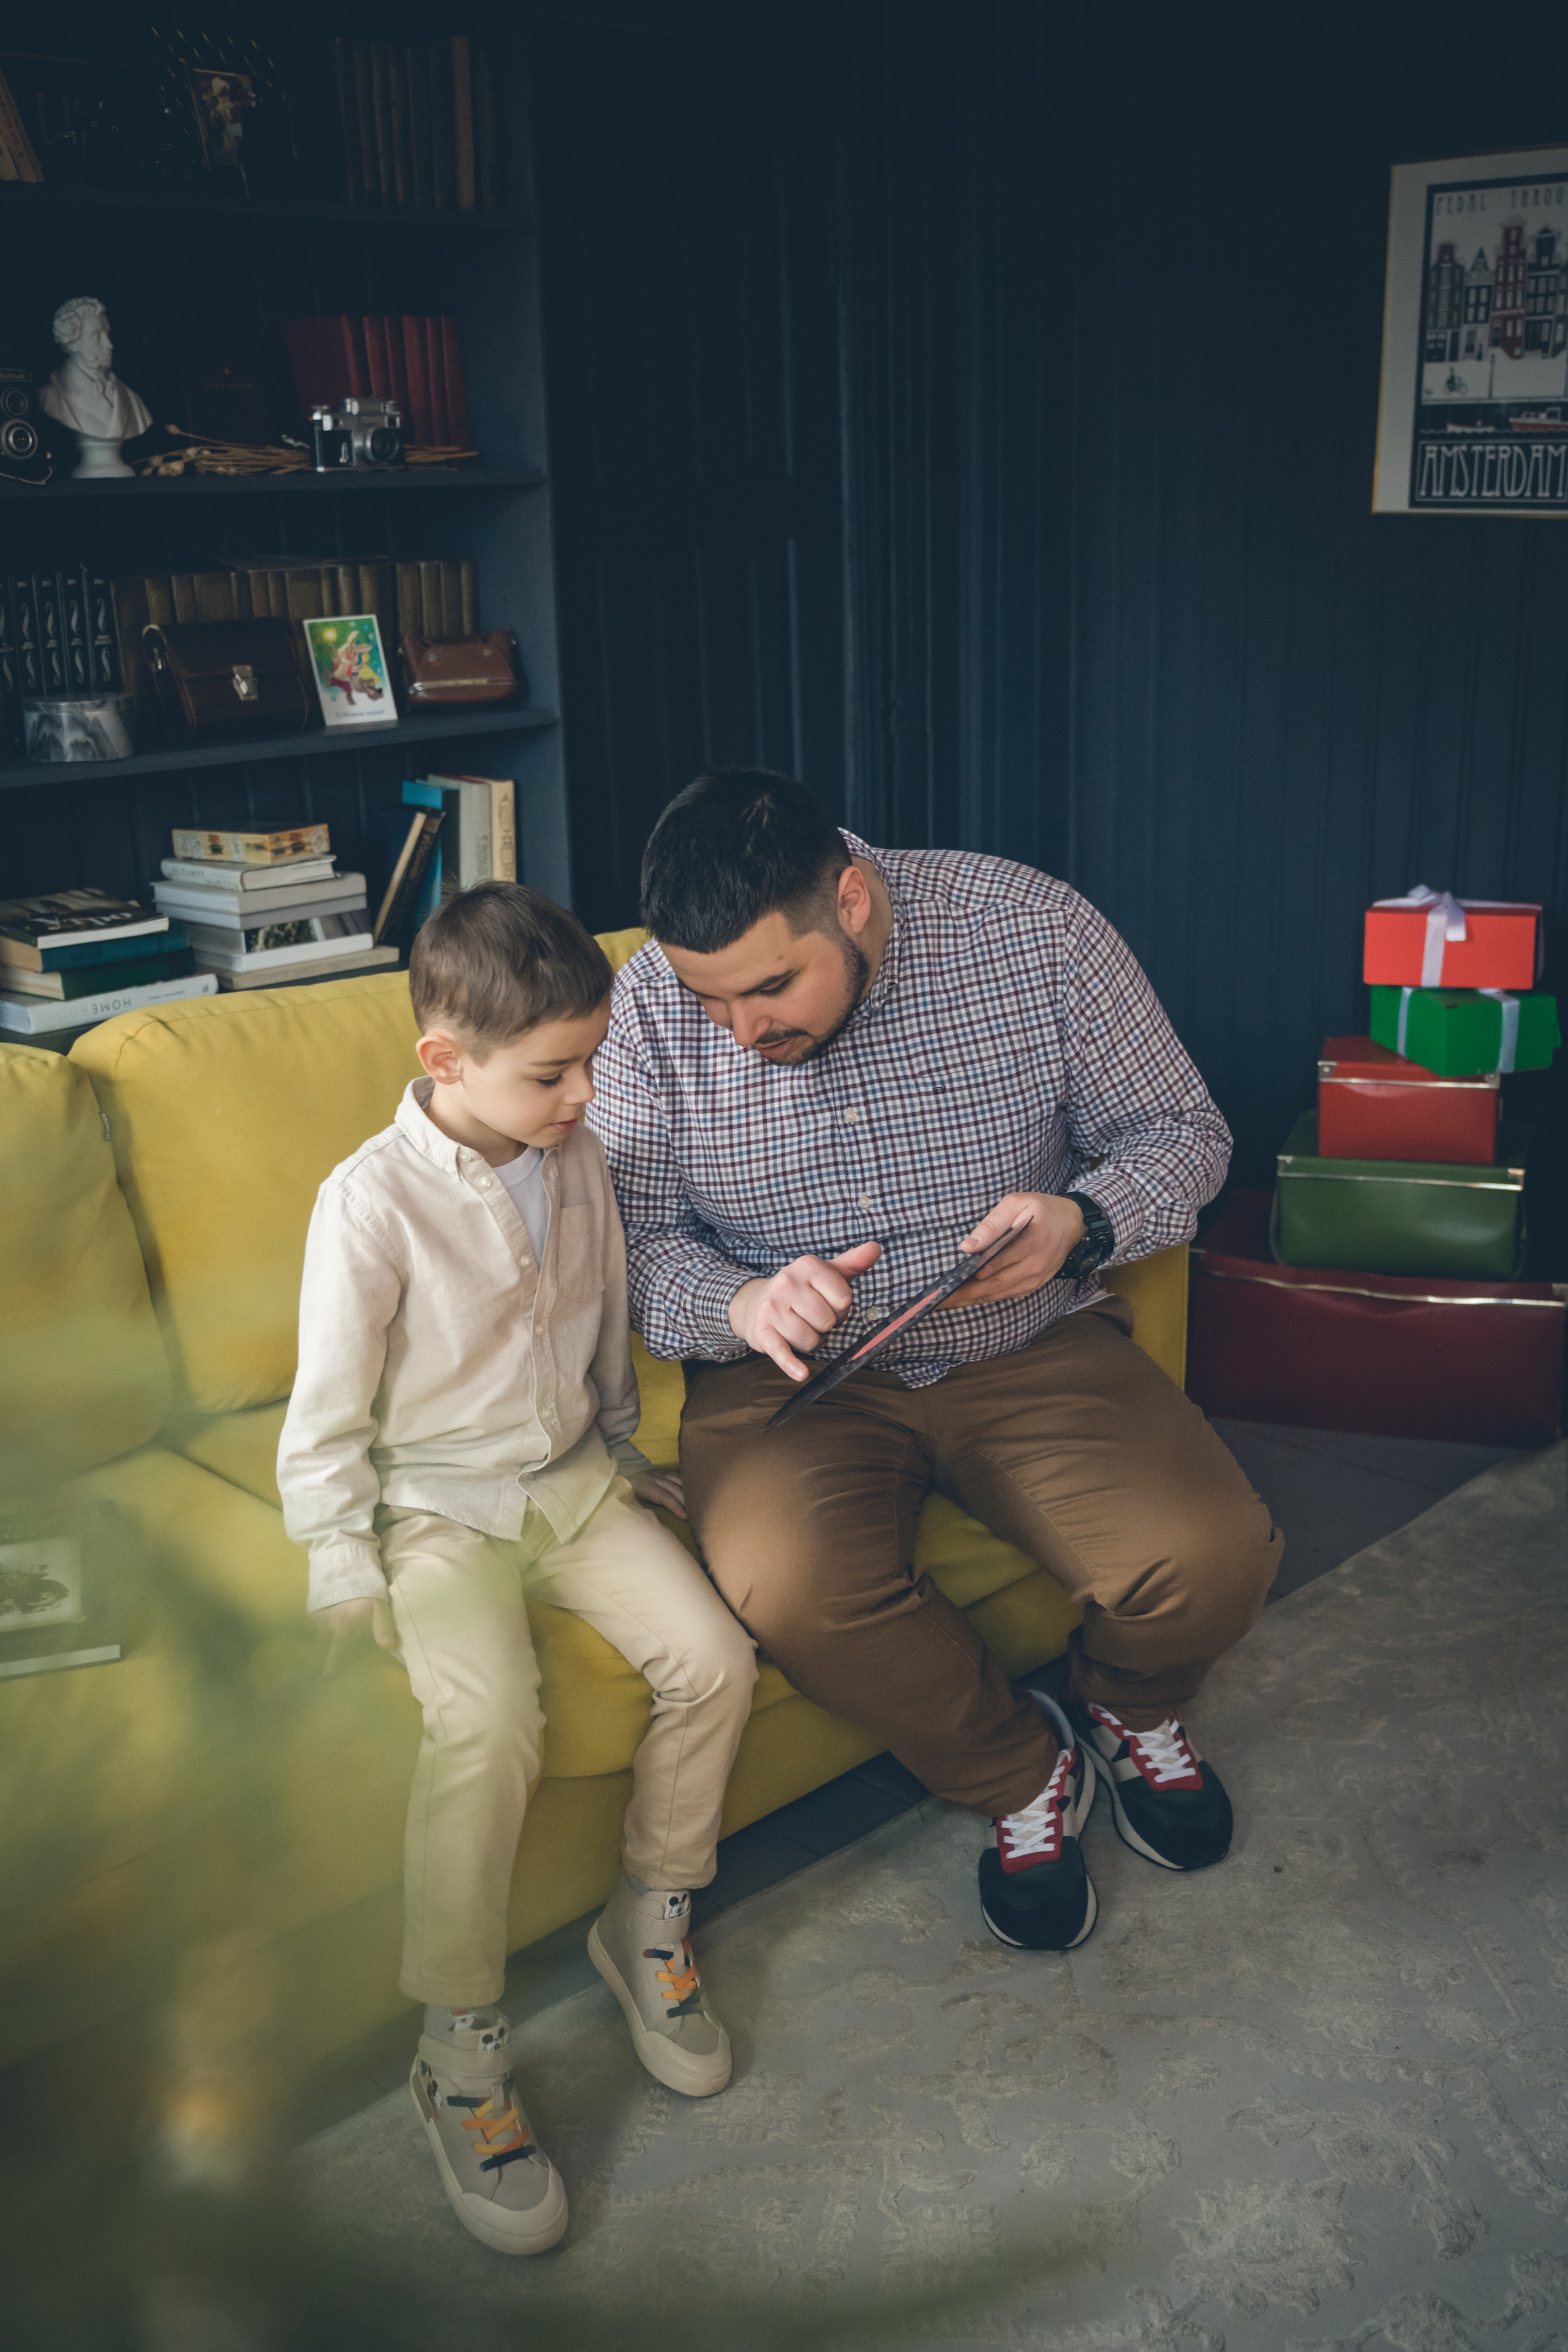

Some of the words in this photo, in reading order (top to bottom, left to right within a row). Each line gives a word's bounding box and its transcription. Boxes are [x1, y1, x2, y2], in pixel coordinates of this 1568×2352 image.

[1436, 192, 1487, 216] PEDAL
[1510, 186, 1568, 209] THROU
[1419, 444, 1567, 497] AMSTERDAM
